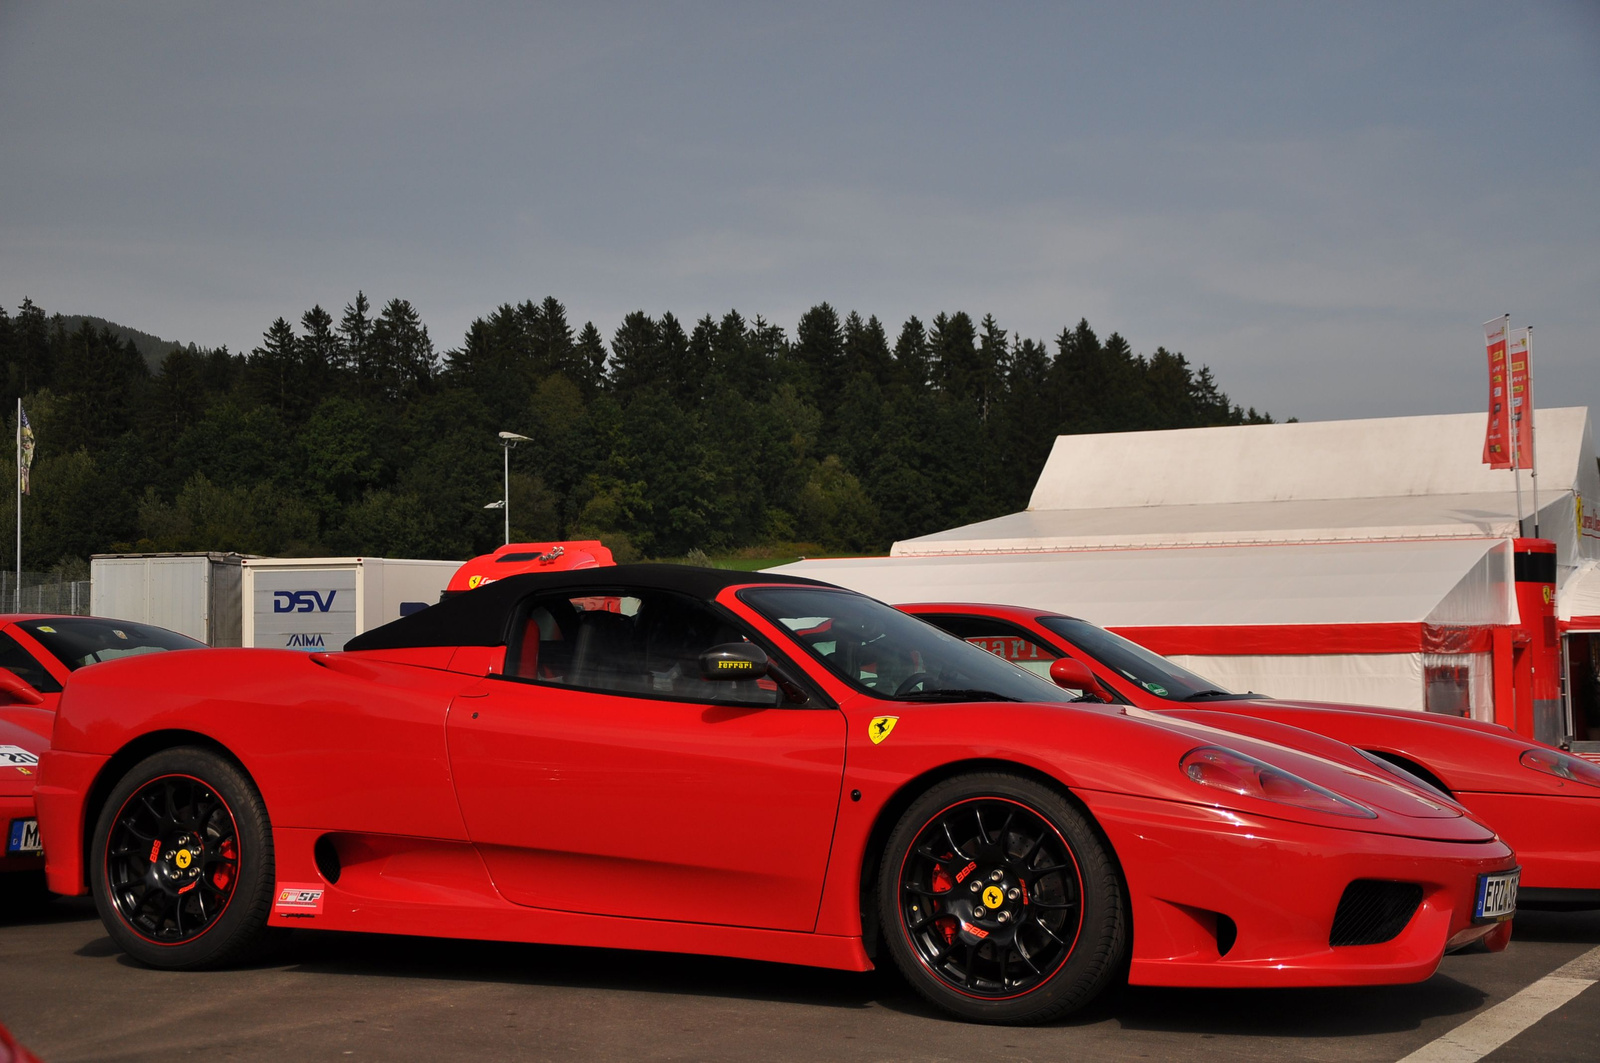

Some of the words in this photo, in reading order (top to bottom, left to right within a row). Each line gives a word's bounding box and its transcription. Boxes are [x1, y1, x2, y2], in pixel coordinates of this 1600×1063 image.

[273, 590, 337, 613] DSV
[286, 633, 325, 647] SAIMA
[718, 660, 752, 669] Ferrari
[149, 839, 162, 864] BBS
[955, 861, 978, 884] BBS
[298, 892, 321, 902] SF
[1484, 880, 1506, 912] ERZ
[962, 922, 990, 939] BBS
